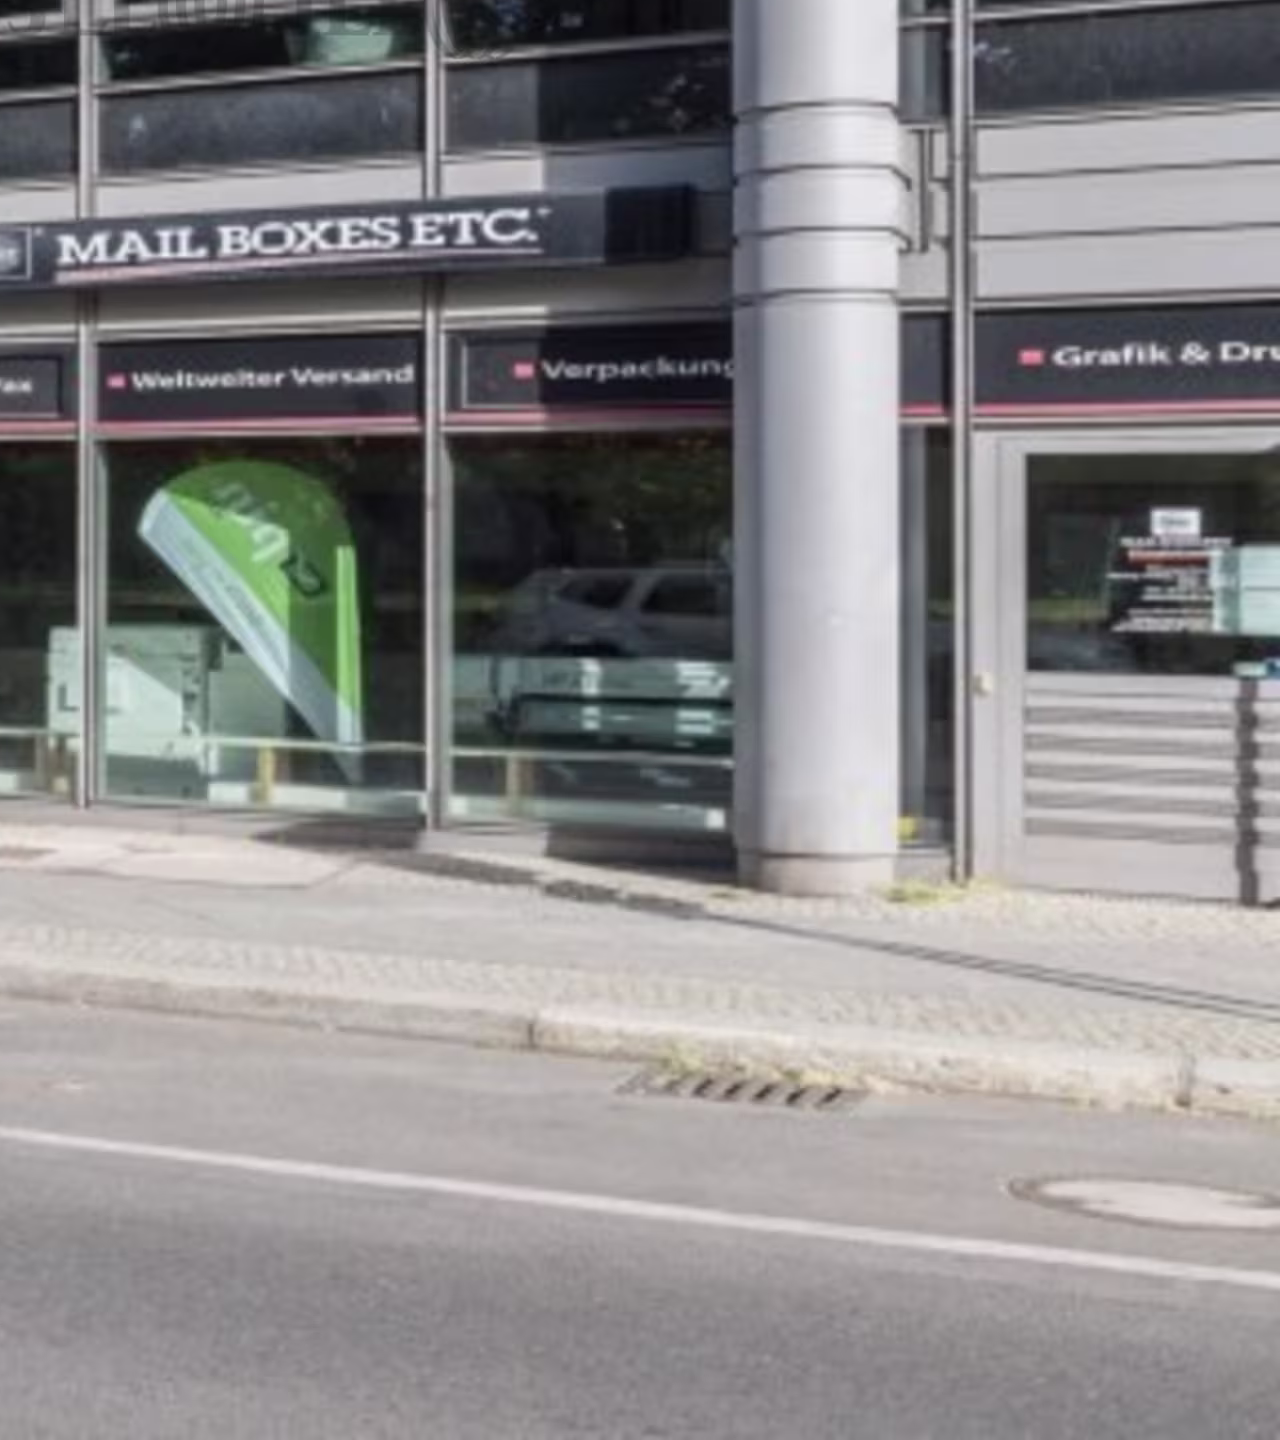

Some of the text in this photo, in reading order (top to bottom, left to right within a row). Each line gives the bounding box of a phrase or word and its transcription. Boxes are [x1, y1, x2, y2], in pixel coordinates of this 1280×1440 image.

[54, 226, 210, 266] MAIL
[216, 215, 402, 256] BOXES
[1051, 341, 1173, 369] Grafik
[1179, 340, 1211, 366] &
[131, 362, 417, 394] Weltweiter Versand
